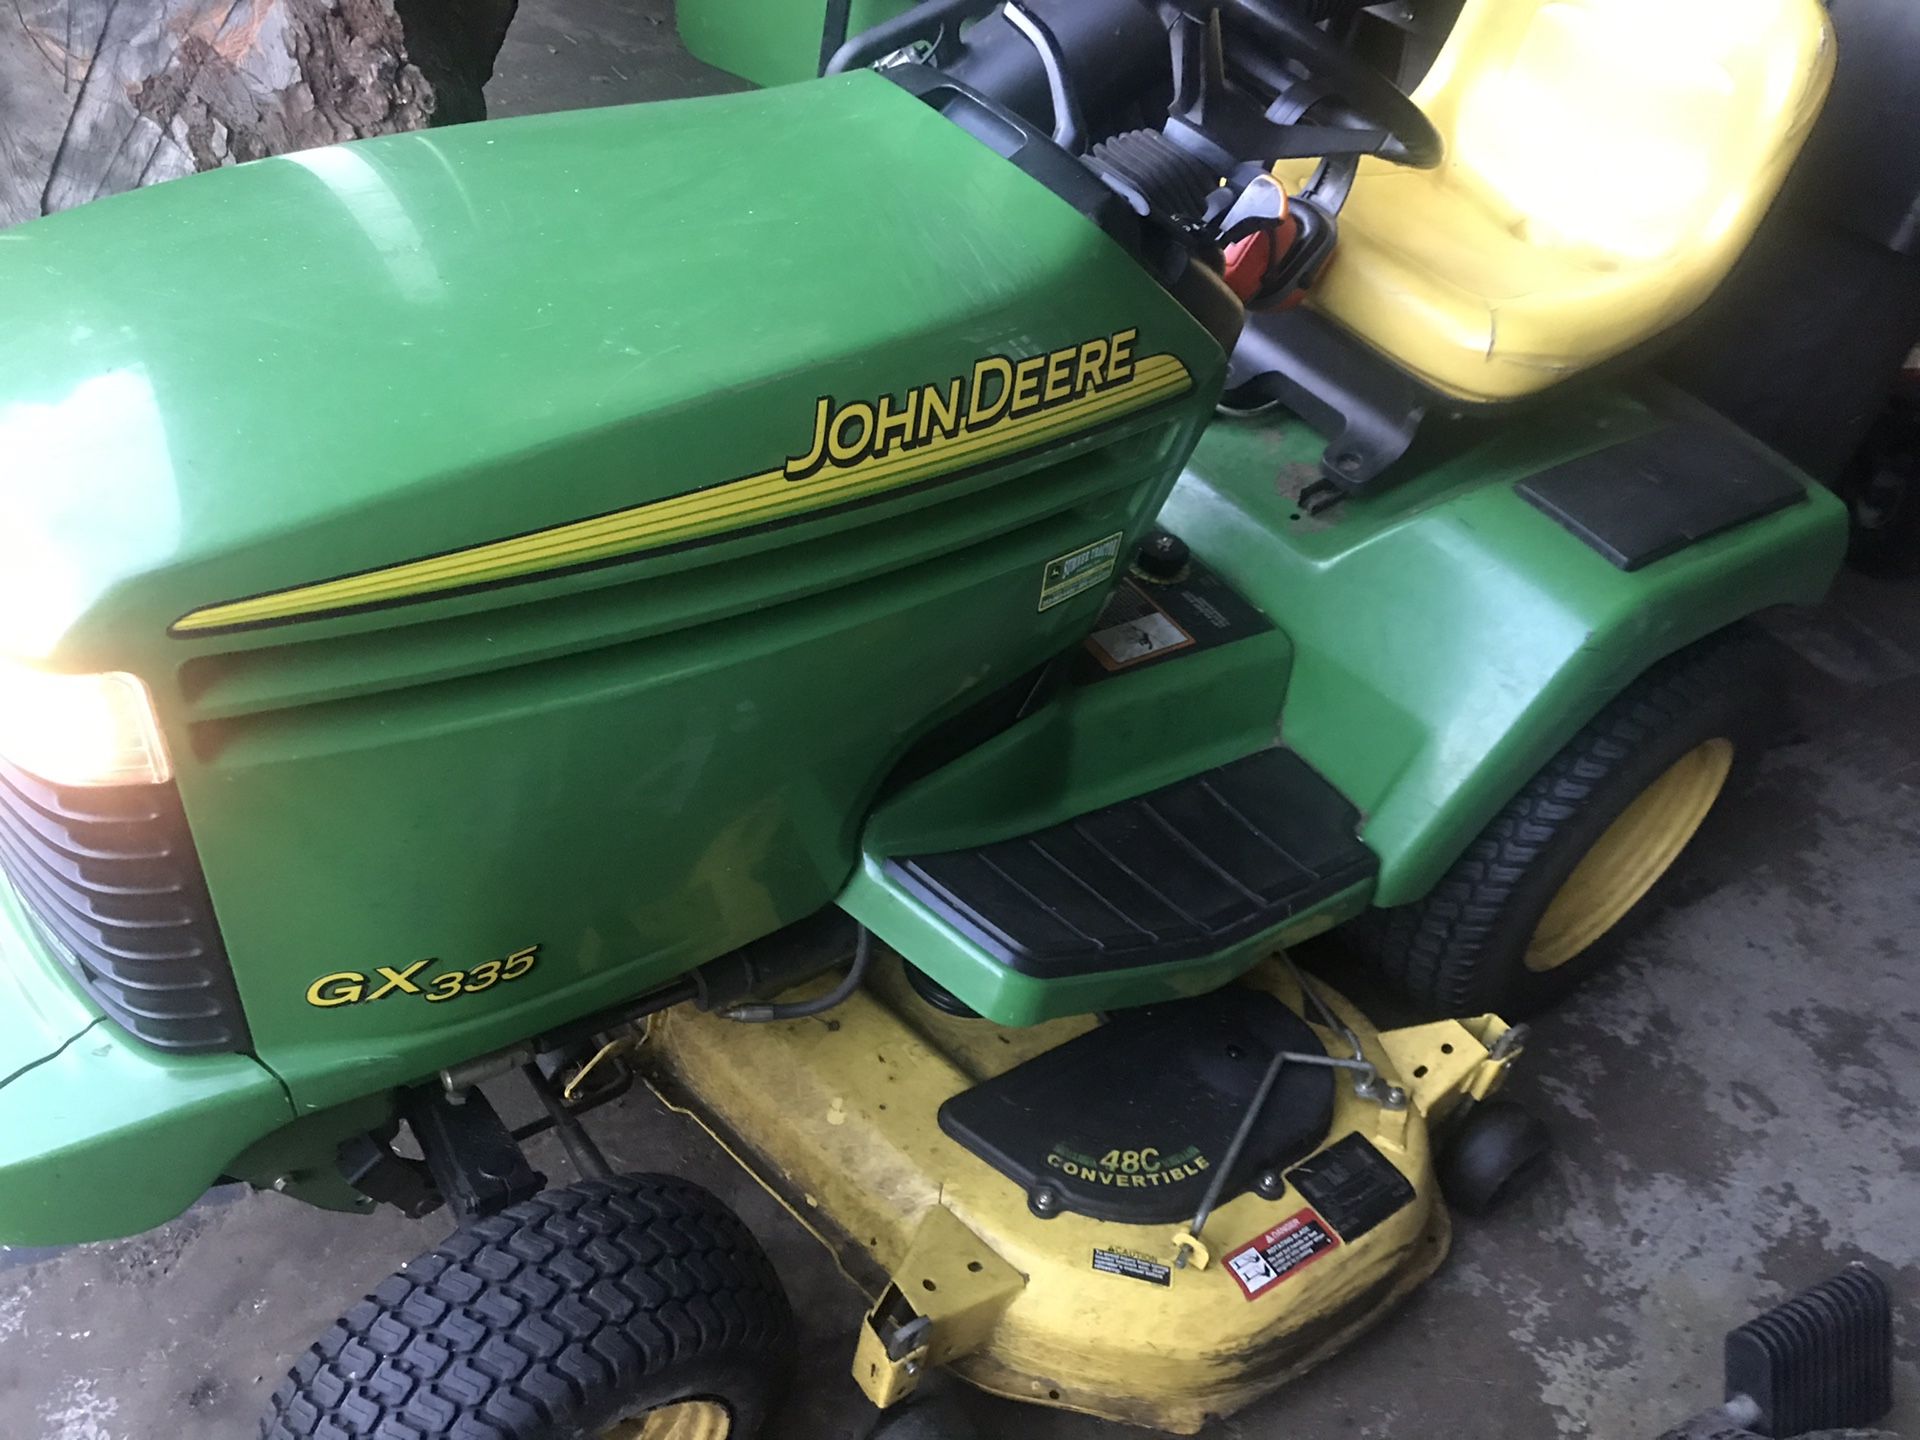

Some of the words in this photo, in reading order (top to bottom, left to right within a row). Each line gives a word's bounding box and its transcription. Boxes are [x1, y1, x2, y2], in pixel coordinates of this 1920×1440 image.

[784, 376, 964, 480] JOHN
[966, 328, 1137, 433] DEERE
[305, 944, 540, 1008] GX335
[1047, 1153, 1210, 1187] CONVERTIBLE
[1100, 1147, 1161, 1173] 48C
[1271, 1218, 1300, 1239] DANGER
[1115, 1246, 1158, 1264] CAUTION
